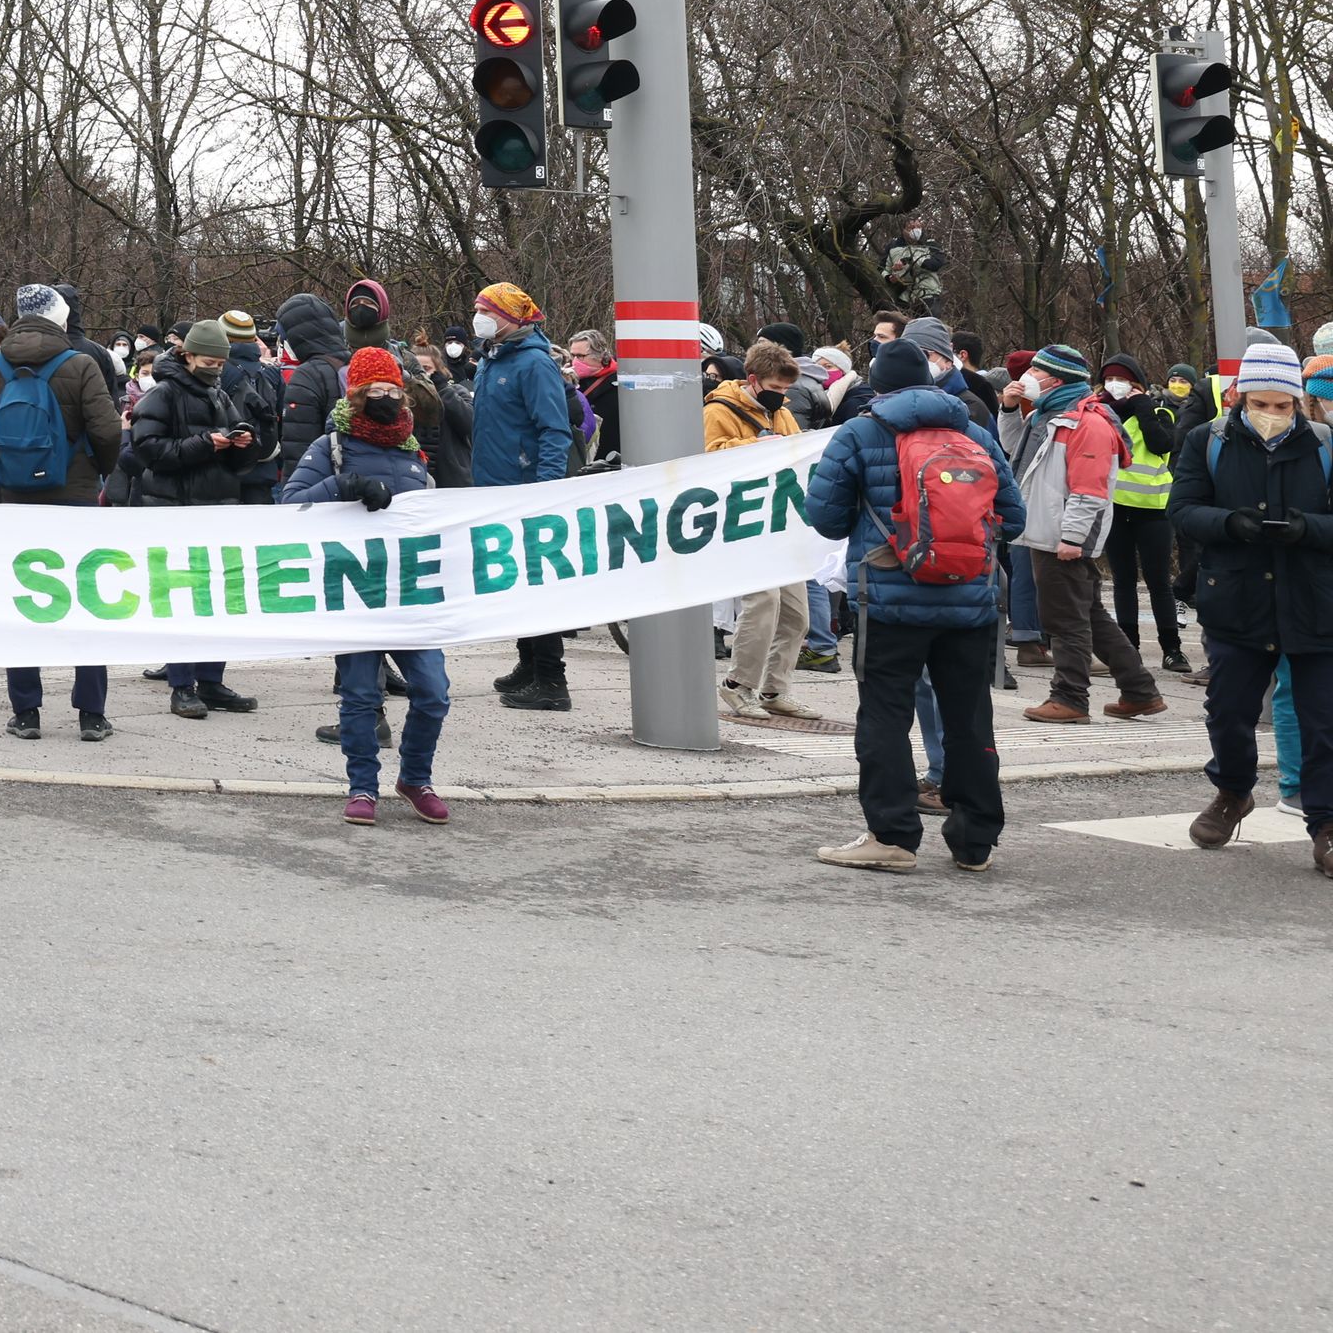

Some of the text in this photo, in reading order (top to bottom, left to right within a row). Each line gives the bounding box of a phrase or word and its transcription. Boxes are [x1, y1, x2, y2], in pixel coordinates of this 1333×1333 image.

[536, 167, 544, 178] 3
[12, 535, 446, 621] SCHIENE
[471, 463, 819, 595] BRINGEN
